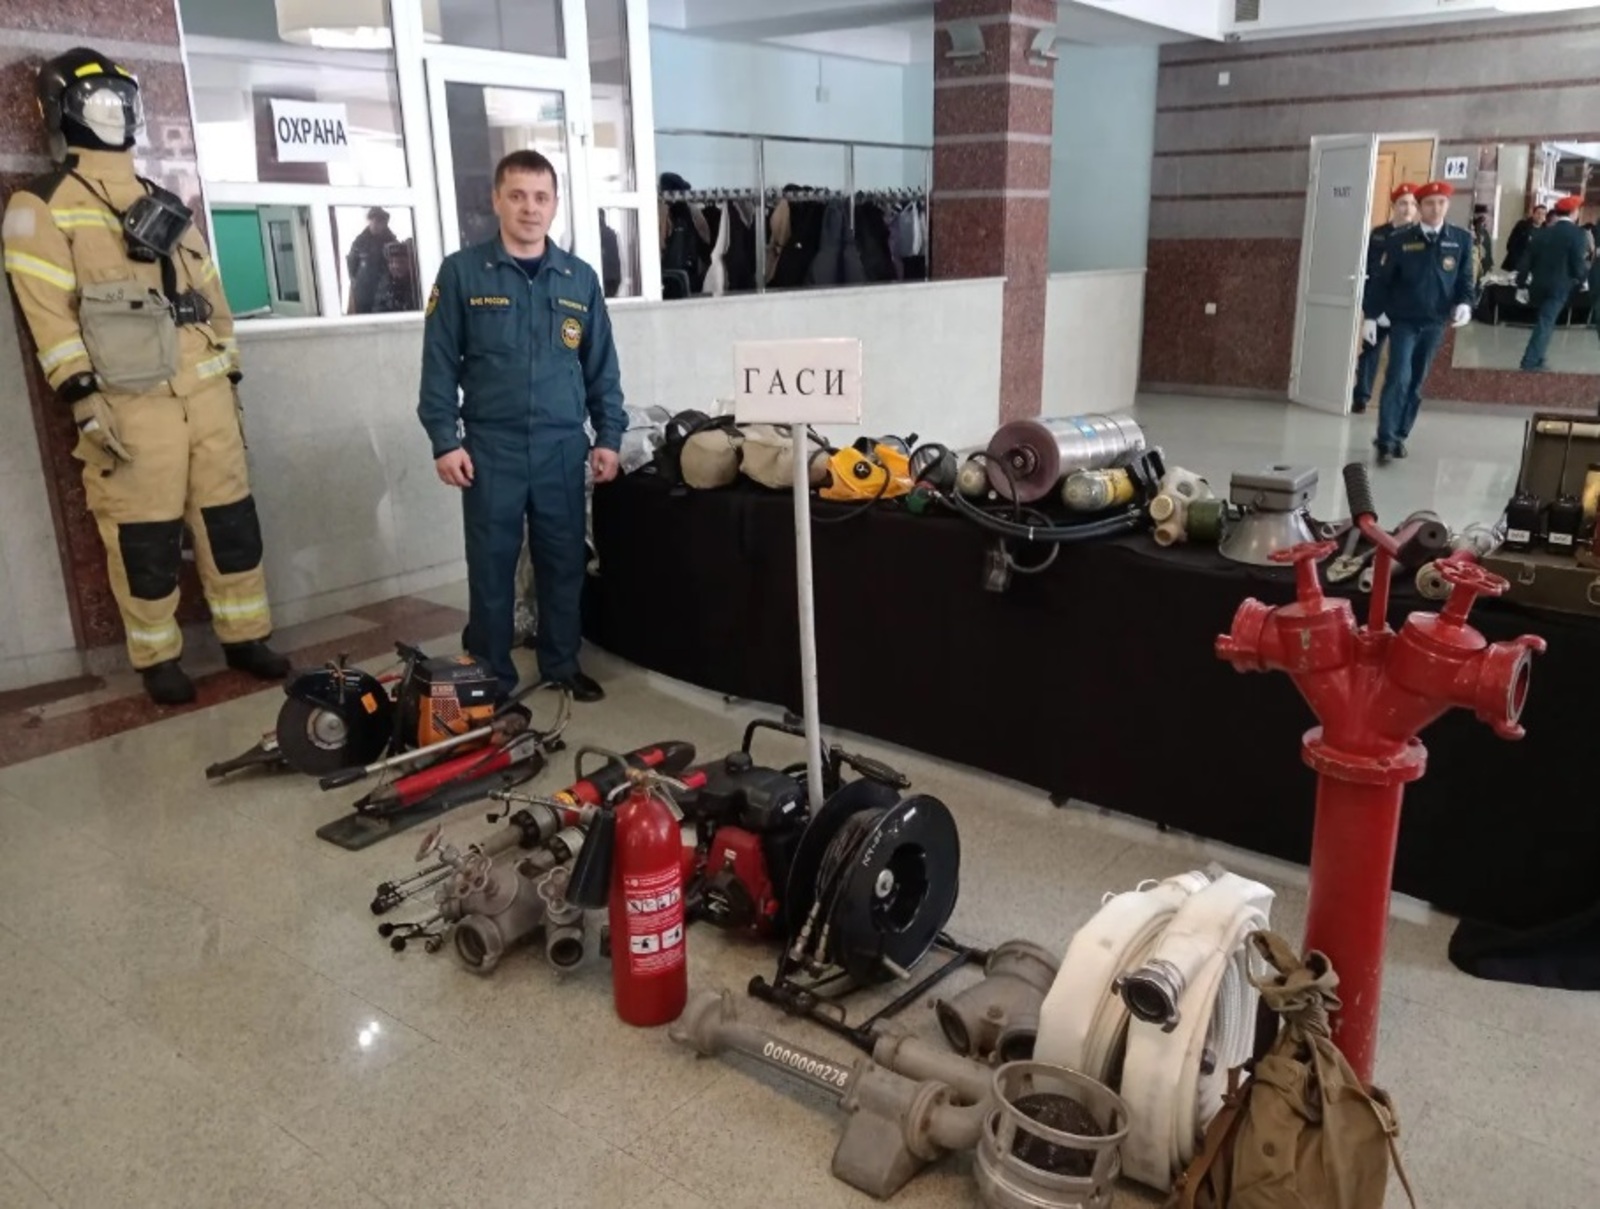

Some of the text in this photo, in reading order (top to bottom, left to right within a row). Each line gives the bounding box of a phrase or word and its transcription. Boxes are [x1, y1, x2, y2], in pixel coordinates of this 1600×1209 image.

[278, 116, 347, 146] ОХРАНА
[743, 367, 845, 395] ГАСИ
[763, 1041, 848, 1087] 0000000278
